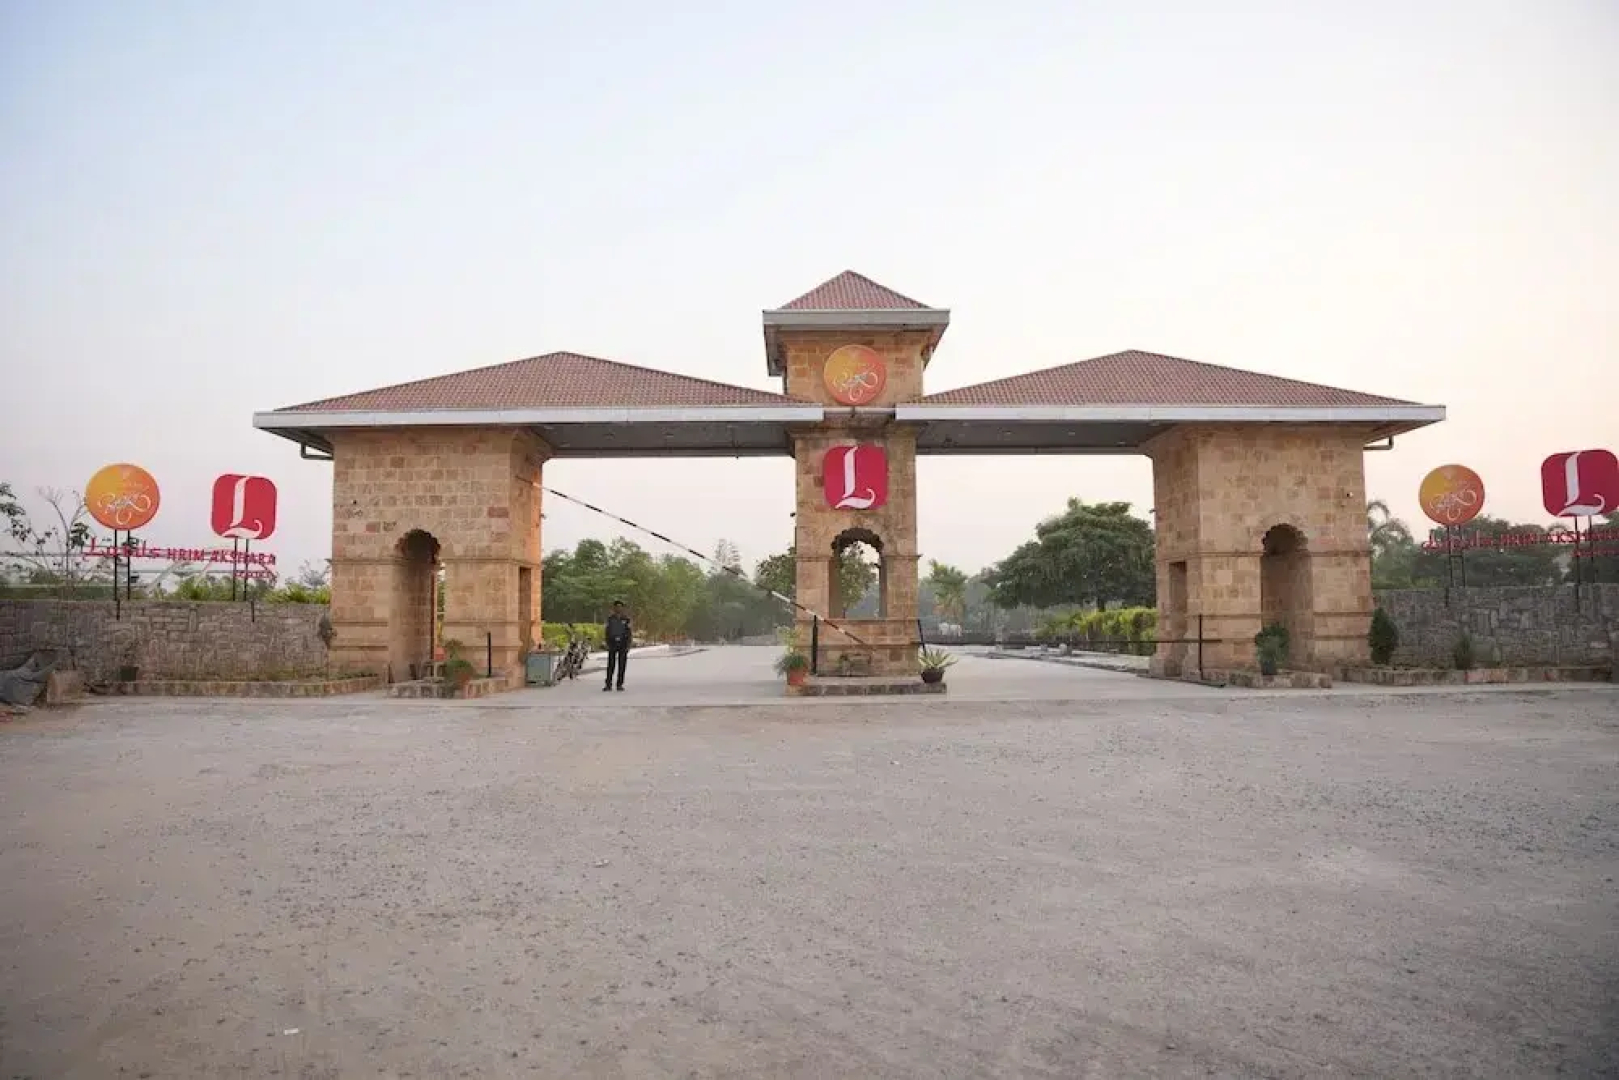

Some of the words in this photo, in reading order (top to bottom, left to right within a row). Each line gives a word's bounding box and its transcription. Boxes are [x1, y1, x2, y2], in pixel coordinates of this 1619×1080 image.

[222, 476, 263, 539] L
[835, 446, 876, 509] L
[1557, 451, 1605, 516] L
[166, 548, 205, 561] HRIM
